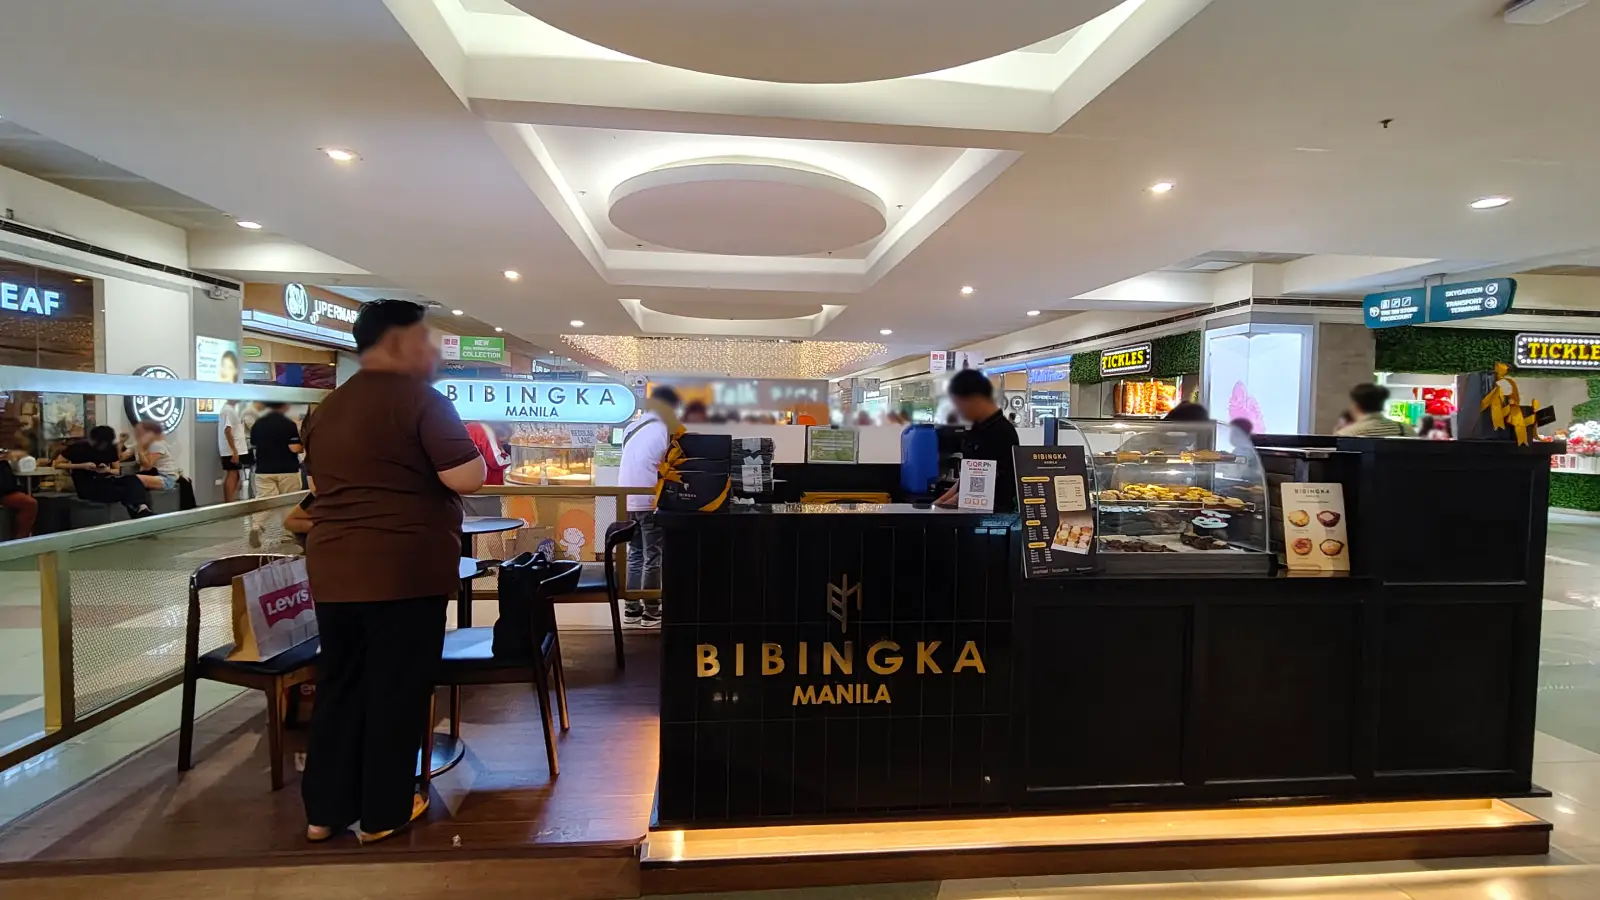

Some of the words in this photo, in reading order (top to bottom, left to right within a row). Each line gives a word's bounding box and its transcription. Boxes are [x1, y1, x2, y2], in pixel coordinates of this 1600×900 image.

[309, 299, 359, 325] SUPERMAR
[1446, 298, 1483, 308] TRANSPORT
[462, 351, 501, 359] COLLECTION
[1102, 350, 1144, 369] TICKLES
[446, 384, 616, 406] BIBINGKA
[504, 406, 560, 418] MANILA
[696, 640, 987, 677] BIBINGKA
[791, 683, 892, 706] MANILA
